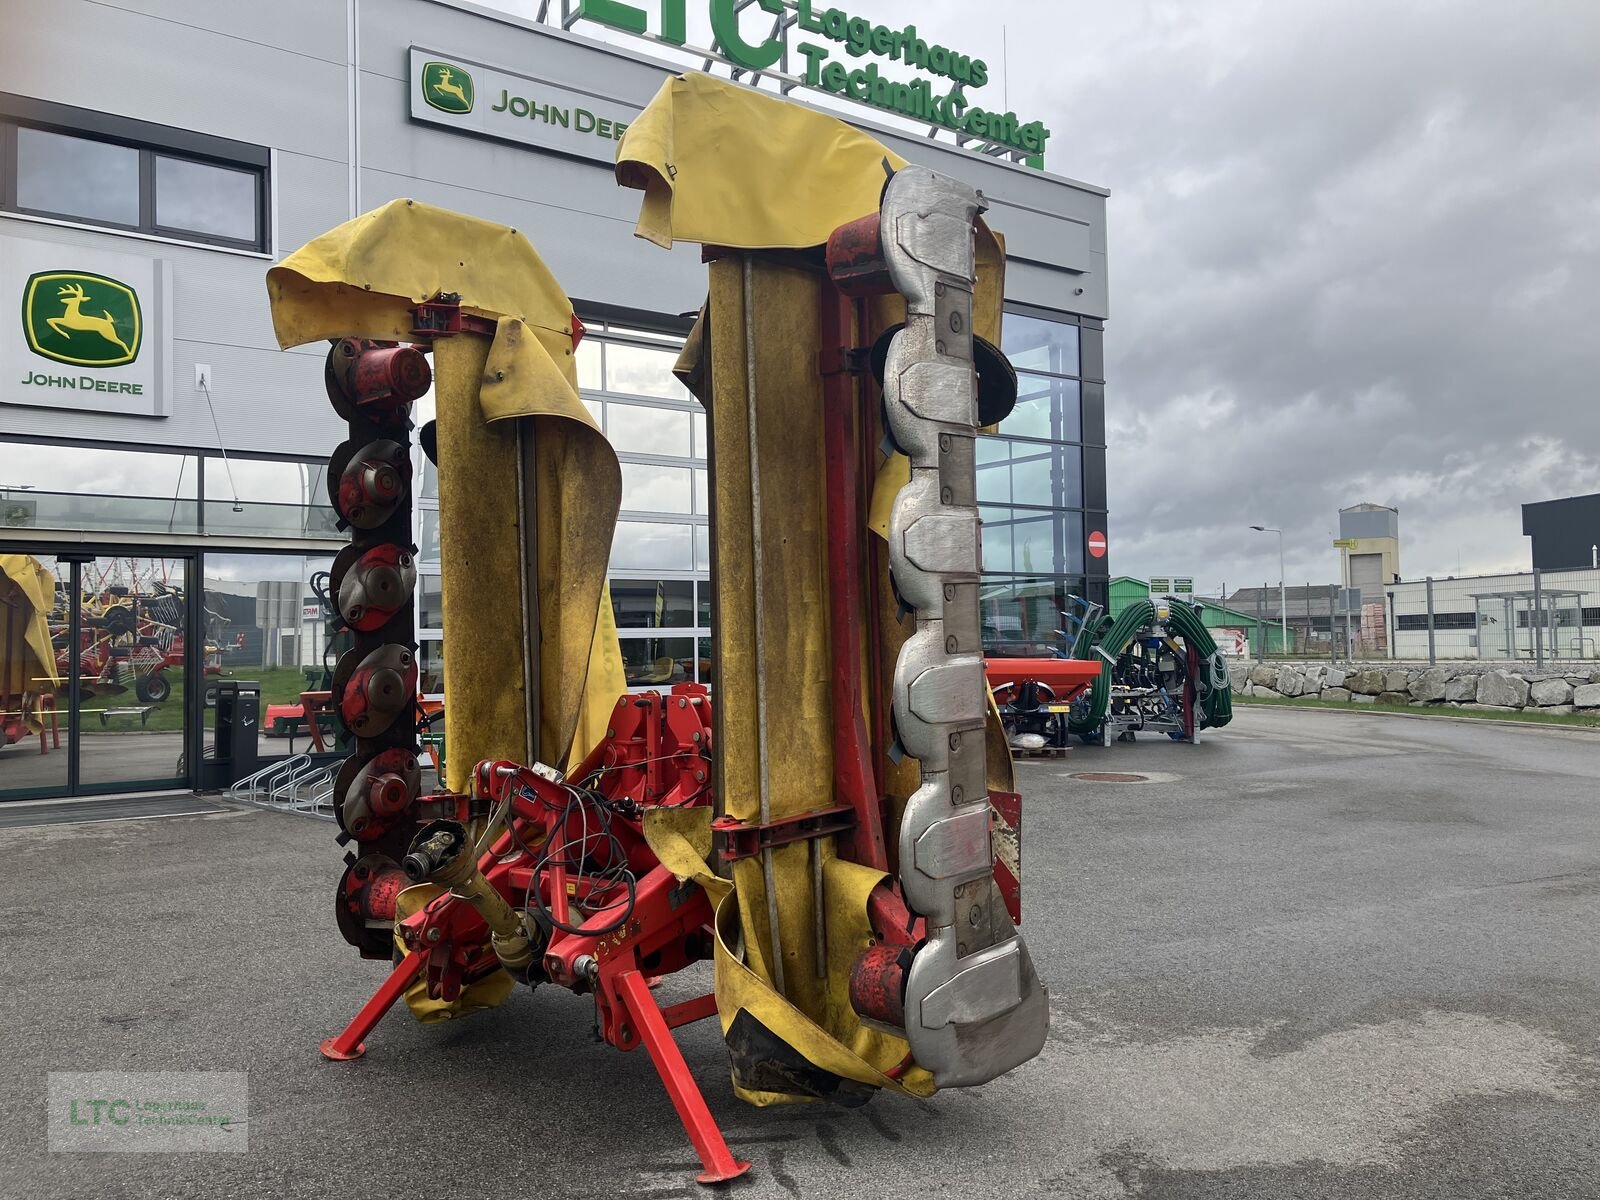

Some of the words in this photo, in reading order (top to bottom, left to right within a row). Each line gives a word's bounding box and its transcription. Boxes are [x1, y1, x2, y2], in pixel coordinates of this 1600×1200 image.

[797, 0, 988, 88] Lagerhaus
[492, 89, 569, 128] JOHN
[797, 42, 1051, 152] TechnikCenter
[21, 371, 76, 389] JOHN
[79, 376, 143, 395] DEERE
